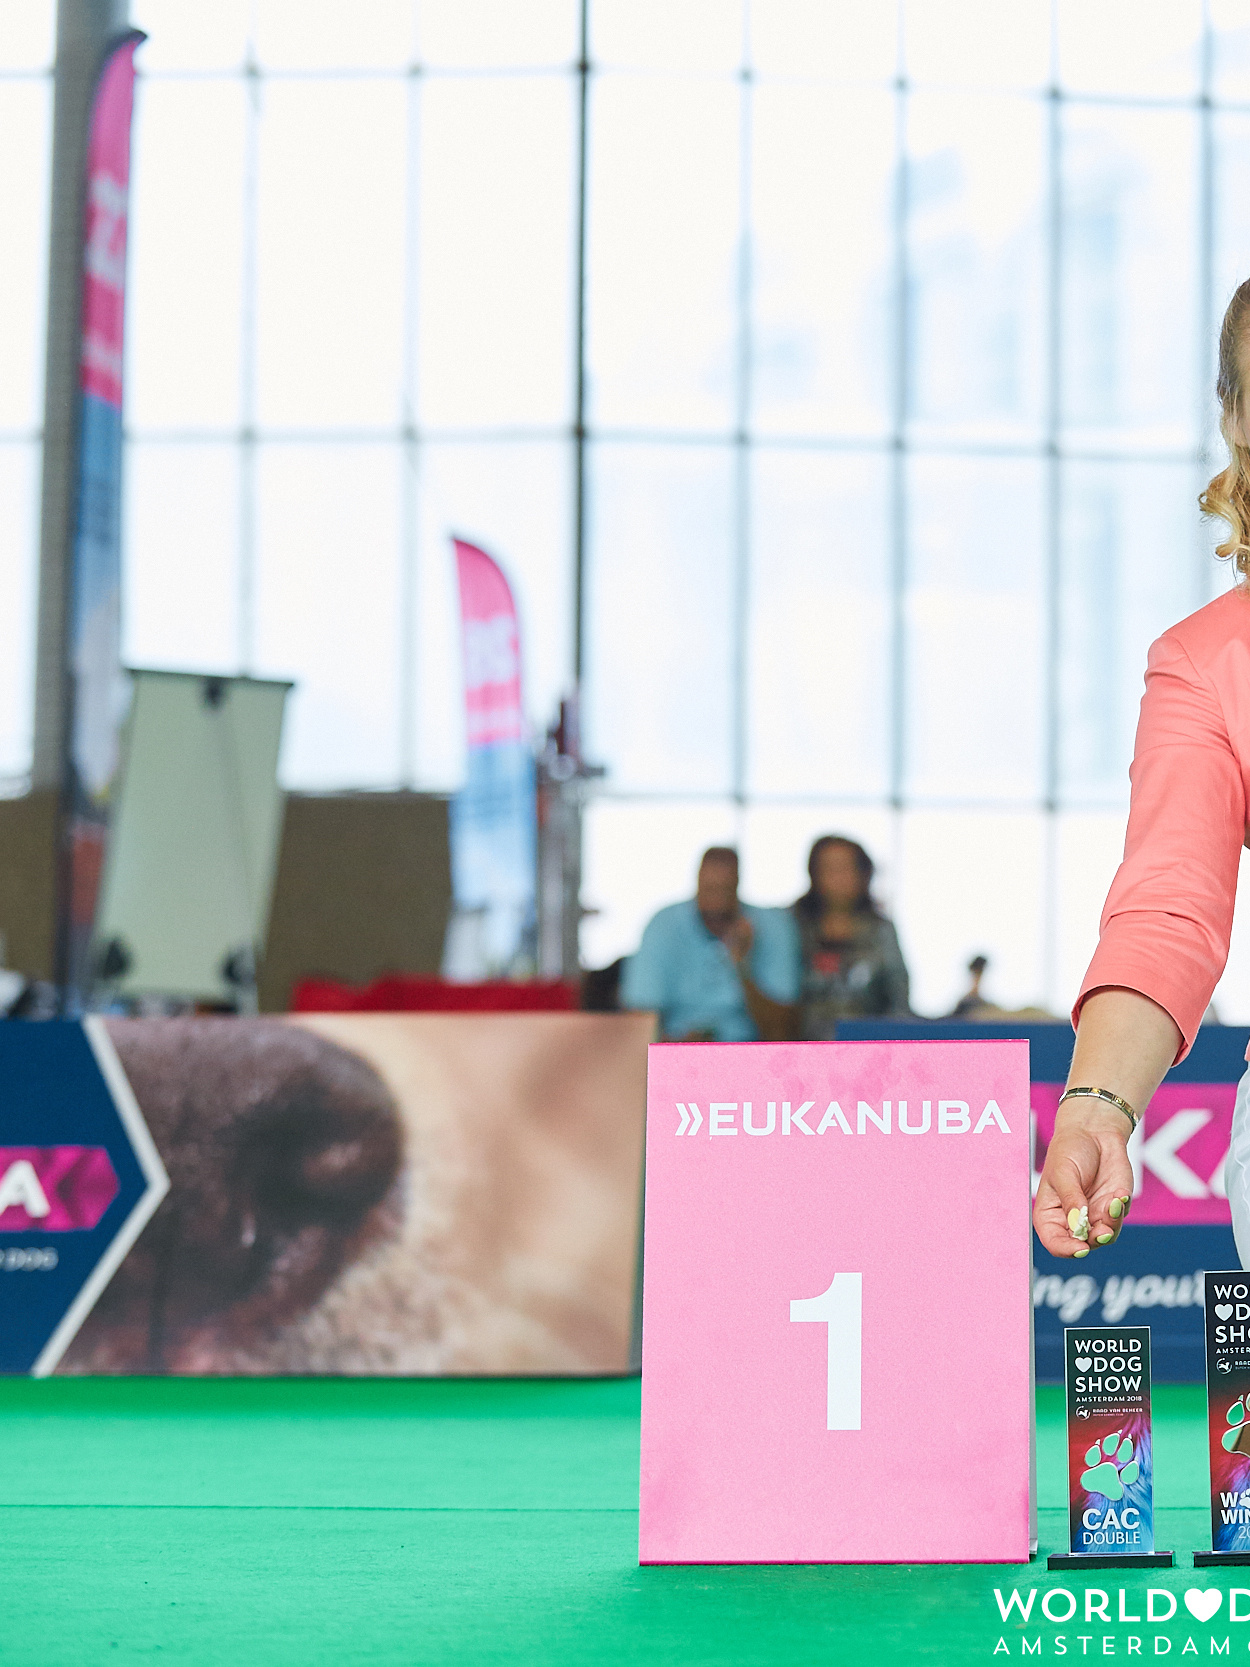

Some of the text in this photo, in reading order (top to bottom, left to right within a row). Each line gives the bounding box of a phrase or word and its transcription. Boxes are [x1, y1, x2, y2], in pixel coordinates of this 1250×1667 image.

[708, 1099, 1012, 1136] EUKANUBA
[789, 1272, 863, 1431] 1
[1074, 1339, 1142, 1354] WORLD
[1093, 1356, 1142, 1373] DOG
[1075, 1375, 1142, 1393] SHOW
[1081, 1507, 1141, 1531] CAC
[1082, 1531, 1141, 1545] DOUBLE
